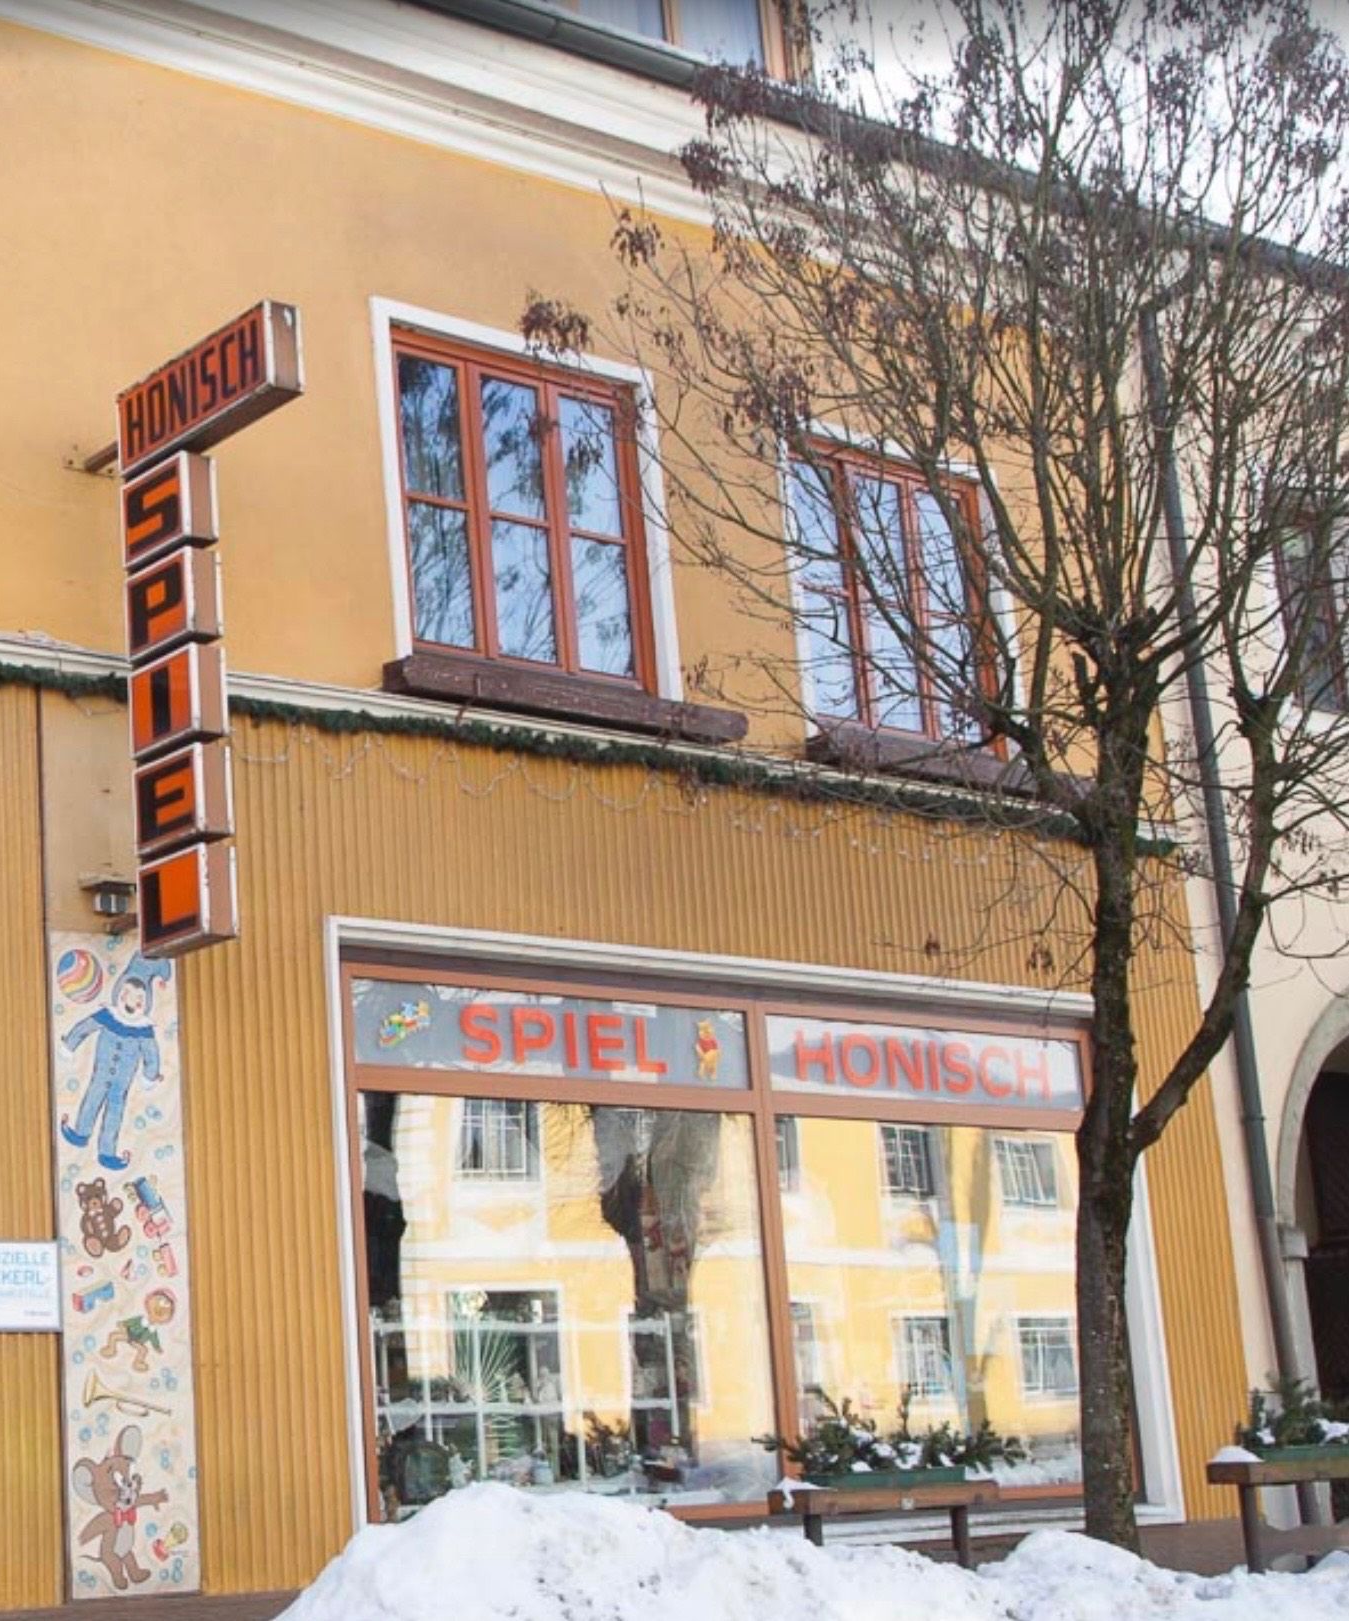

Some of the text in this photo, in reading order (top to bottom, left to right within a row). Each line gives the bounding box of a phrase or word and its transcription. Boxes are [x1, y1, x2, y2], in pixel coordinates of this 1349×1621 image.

[126, 318, 260, 461] HONISCH
[126, 464, 201, 946] SPIEL
[459, 1003, 1053, 1101] SPIEL HONISCH
